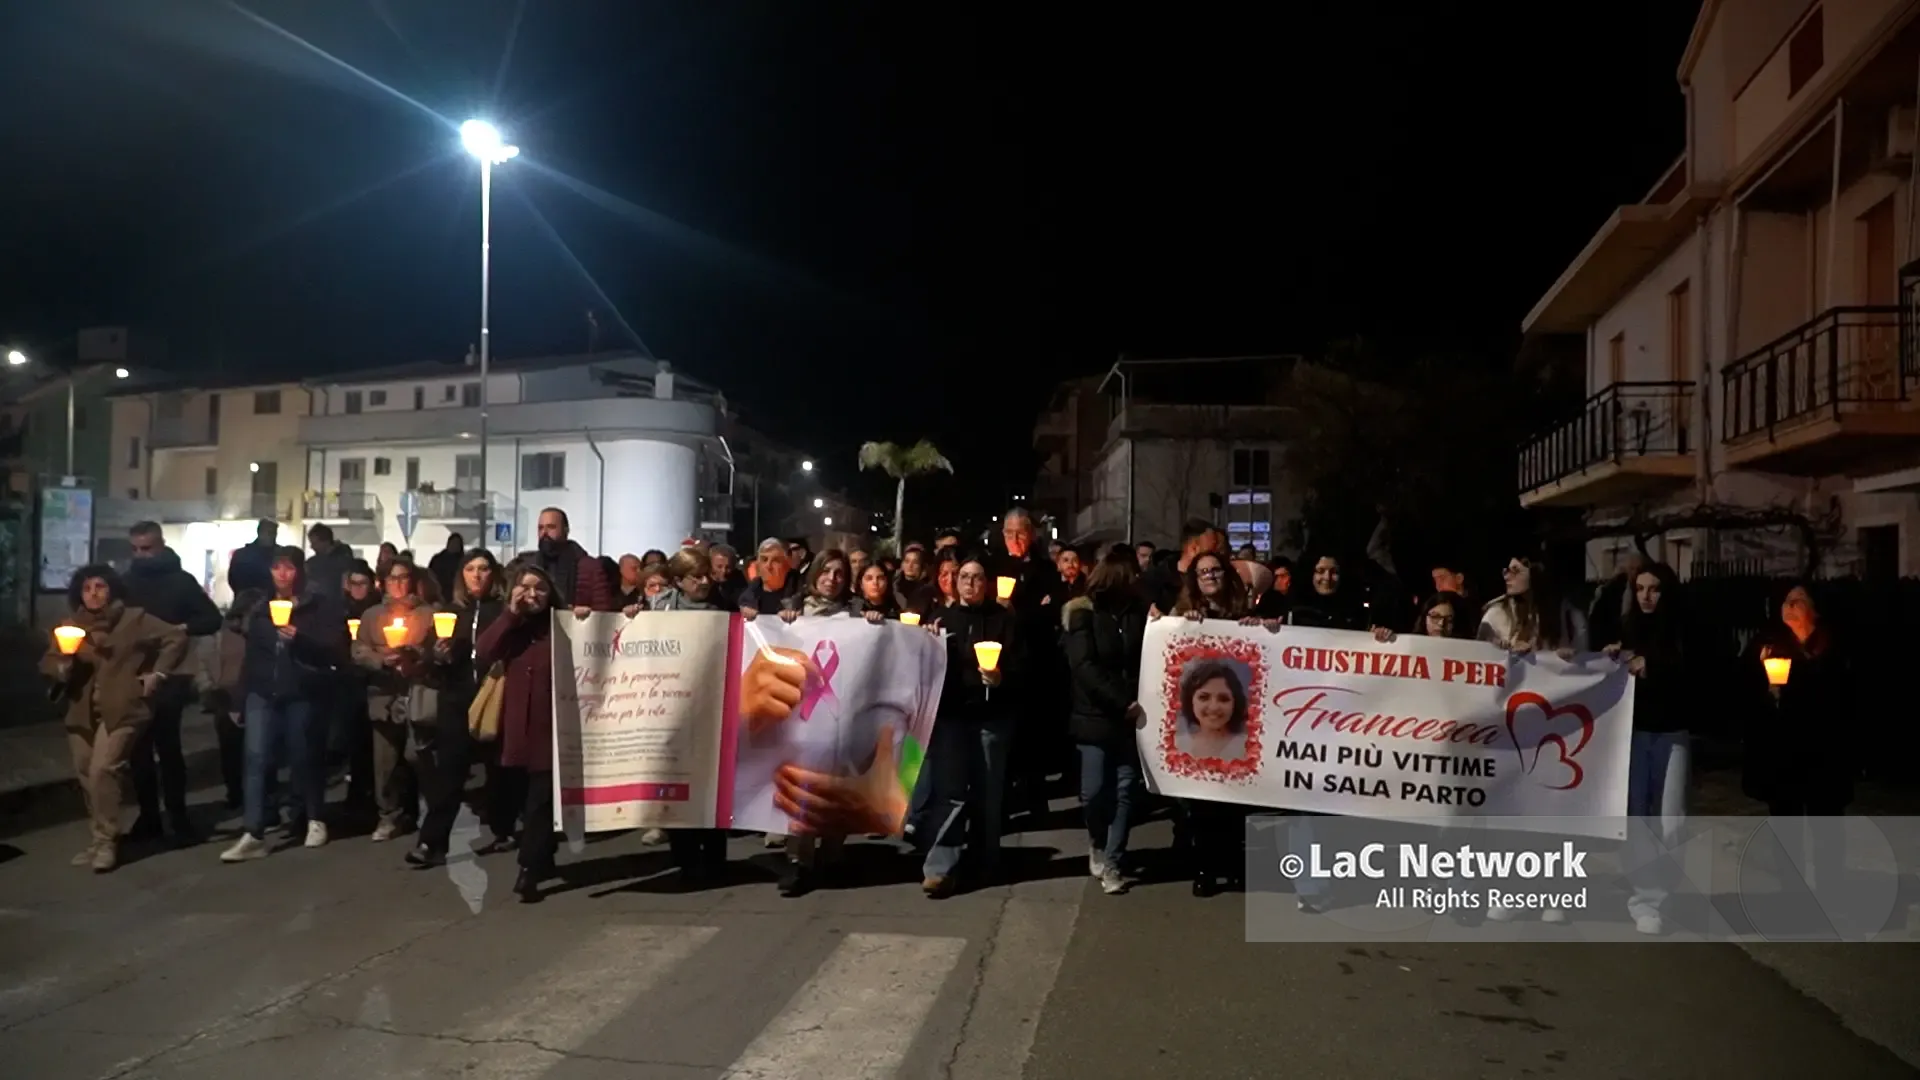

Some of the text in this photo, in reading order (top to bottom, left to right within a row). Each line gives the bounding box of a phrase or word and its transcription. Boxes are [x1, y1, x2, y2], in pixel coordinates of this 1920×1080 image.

[621, 639, 681, 657] MEDITERRANEA
[1282, 646, 1507, 688] GIUSTIZIA PER
[1273, 686, 1501, 745] Francesca
[1276, 741, 1496, 778] MAI PIÙ VITTIME
[1284, 770, 1487, 808] IN SALA PARTO
